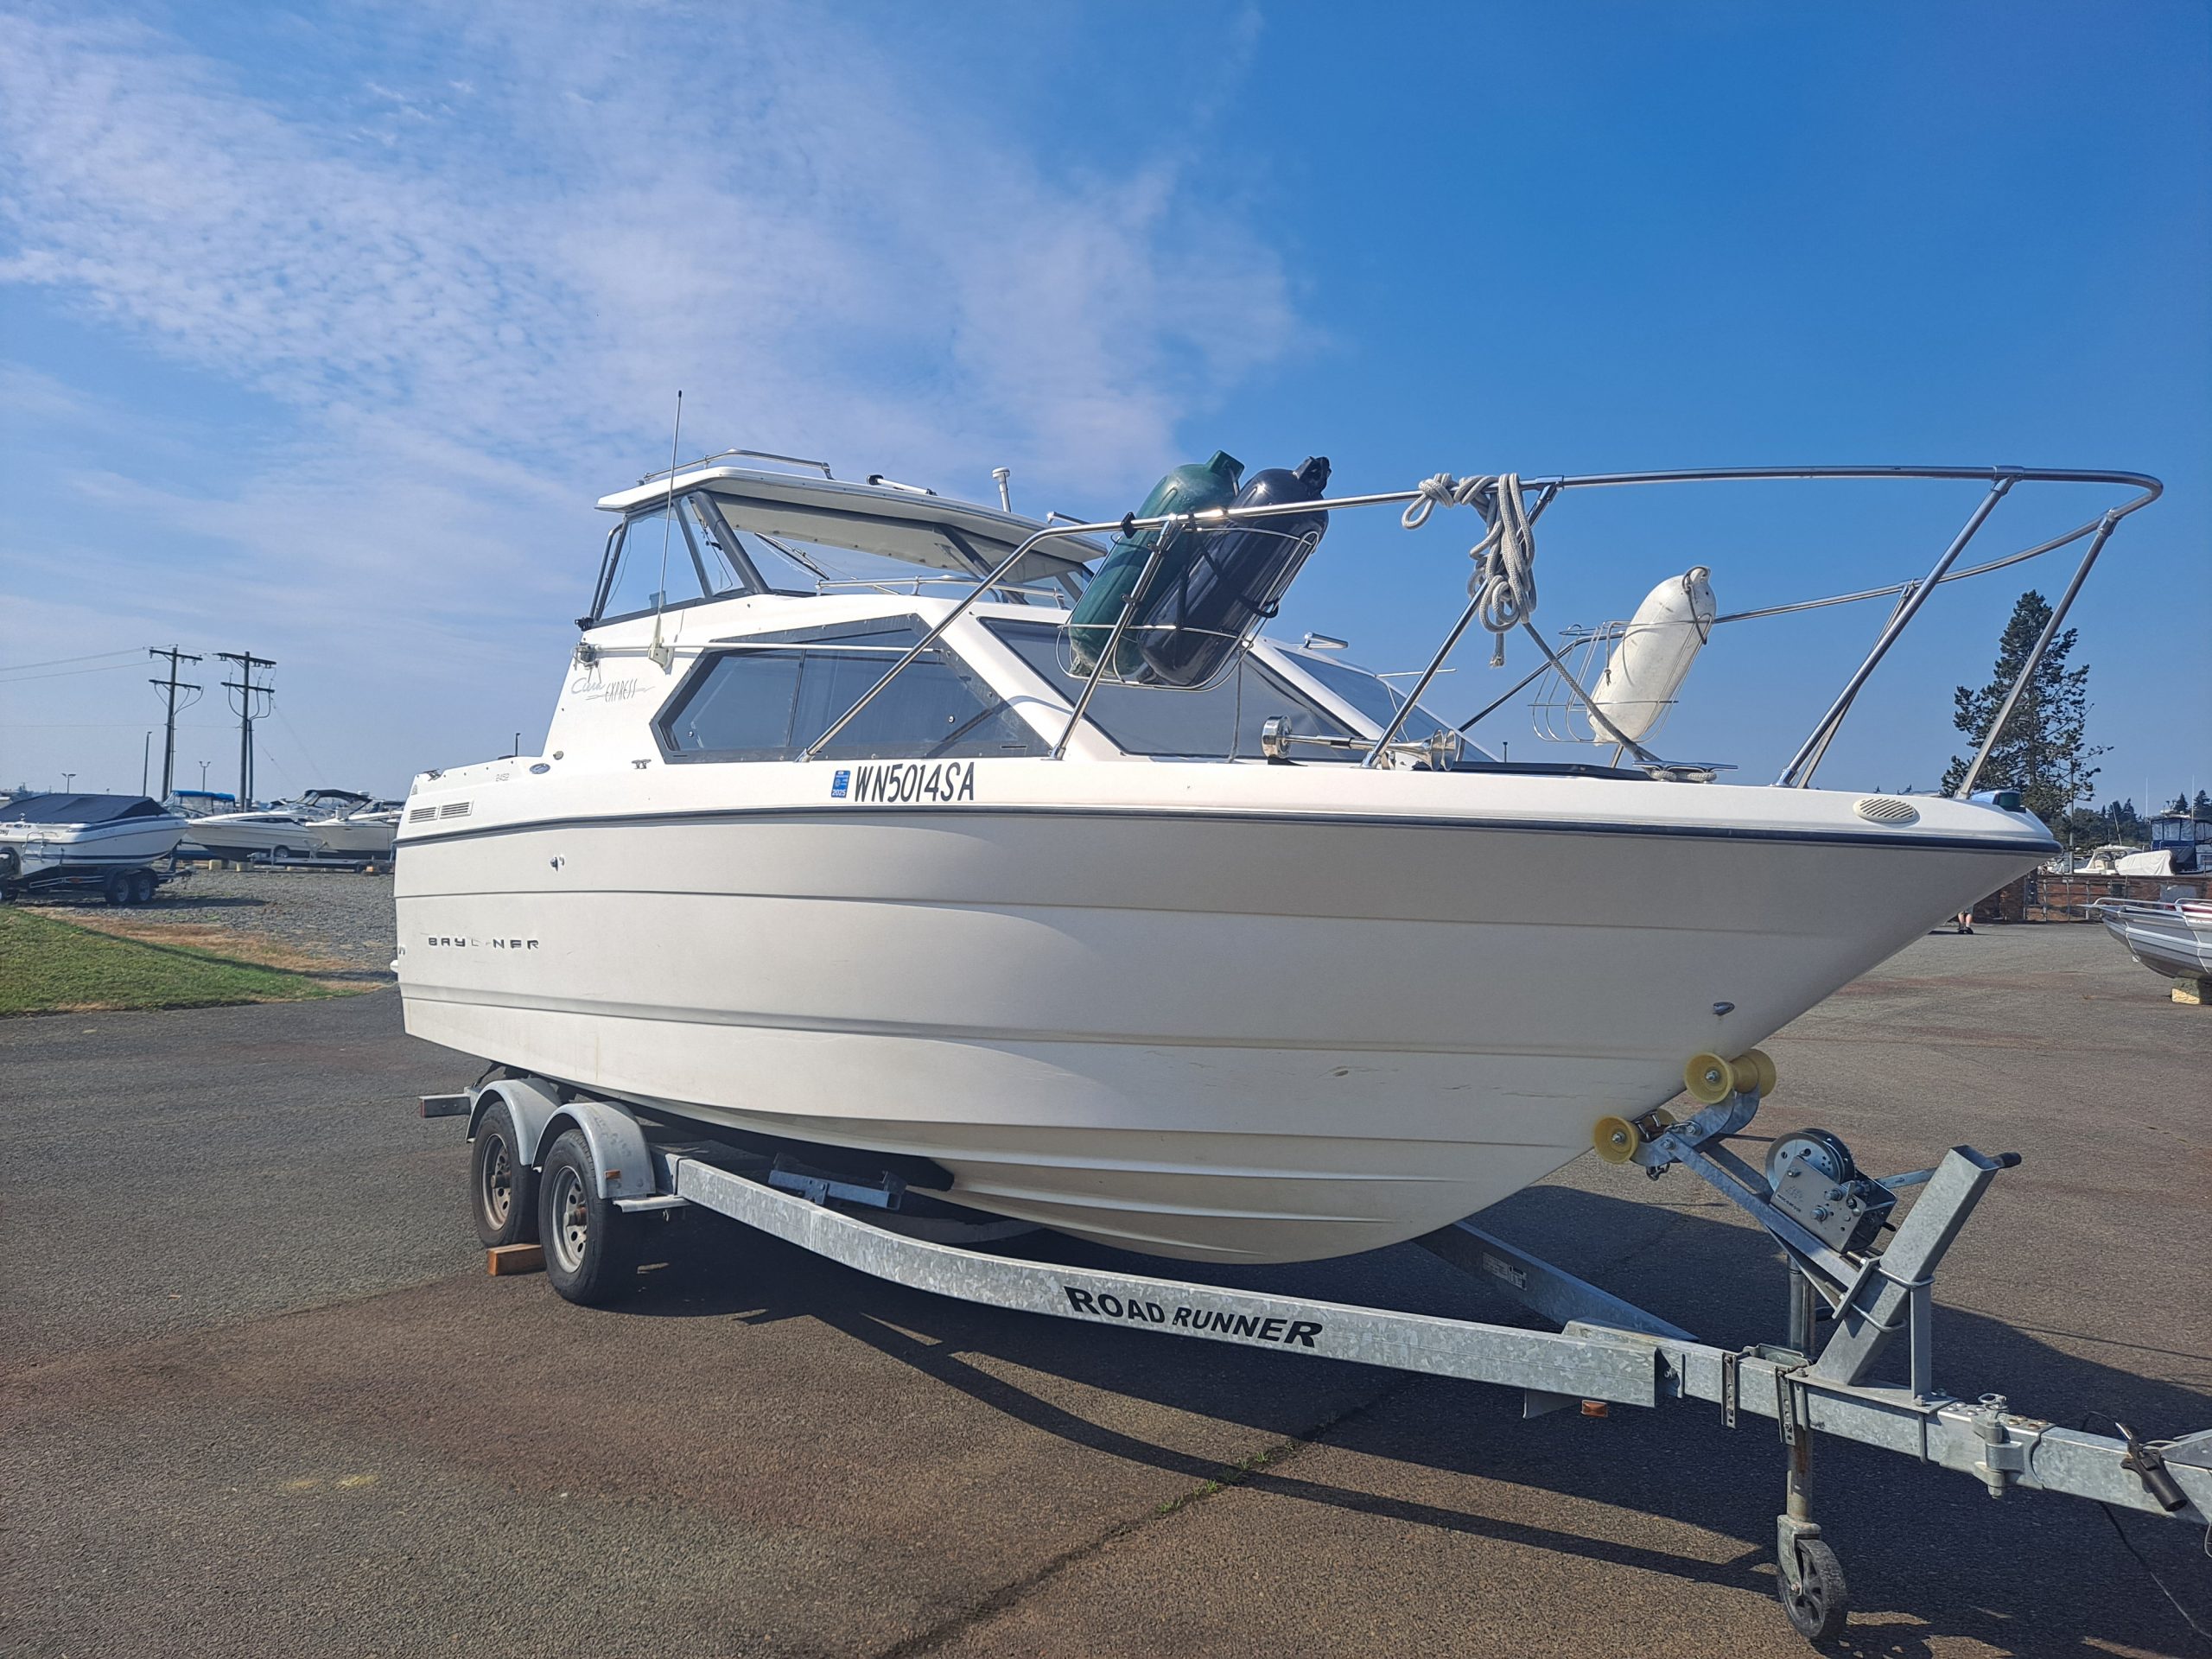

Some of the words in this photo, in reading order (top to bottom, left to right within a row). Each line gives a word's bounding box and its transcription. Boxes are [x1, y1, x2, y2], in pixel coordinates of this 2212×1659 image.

[605, 678, 638, 702] EXPRESS
[855, 761, 975, 803] WN5014SA
[428, 937, 539, 950] BAYLNER
[1064, 1286, 1166, 1325] ROAD
[1172, 1306, 1324, 1349] RUNNER
